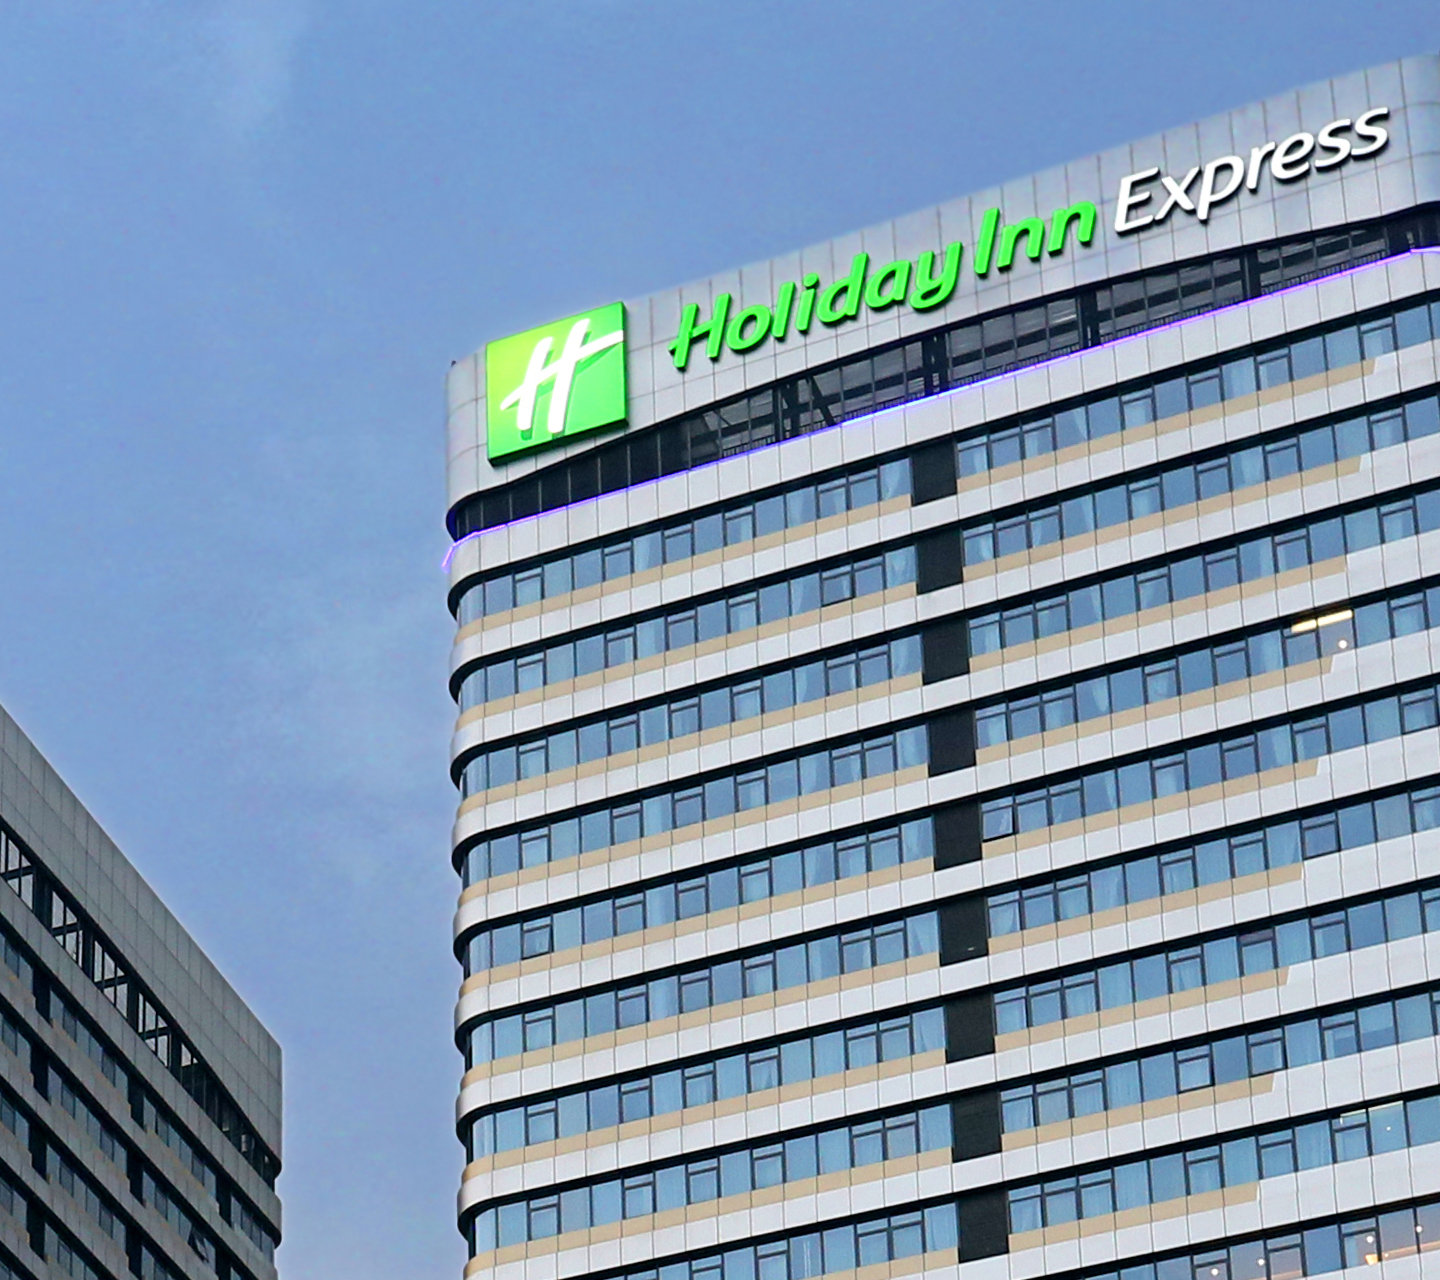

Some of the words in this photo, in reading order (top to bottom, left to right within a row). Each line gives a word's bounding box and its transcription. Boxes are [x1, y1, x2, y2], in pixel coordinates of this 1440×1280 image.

[668, 240, 964, 369] Holiday
[974, 200, 1098, 275] Inn
[1114, 106, 1389, 233] Express
